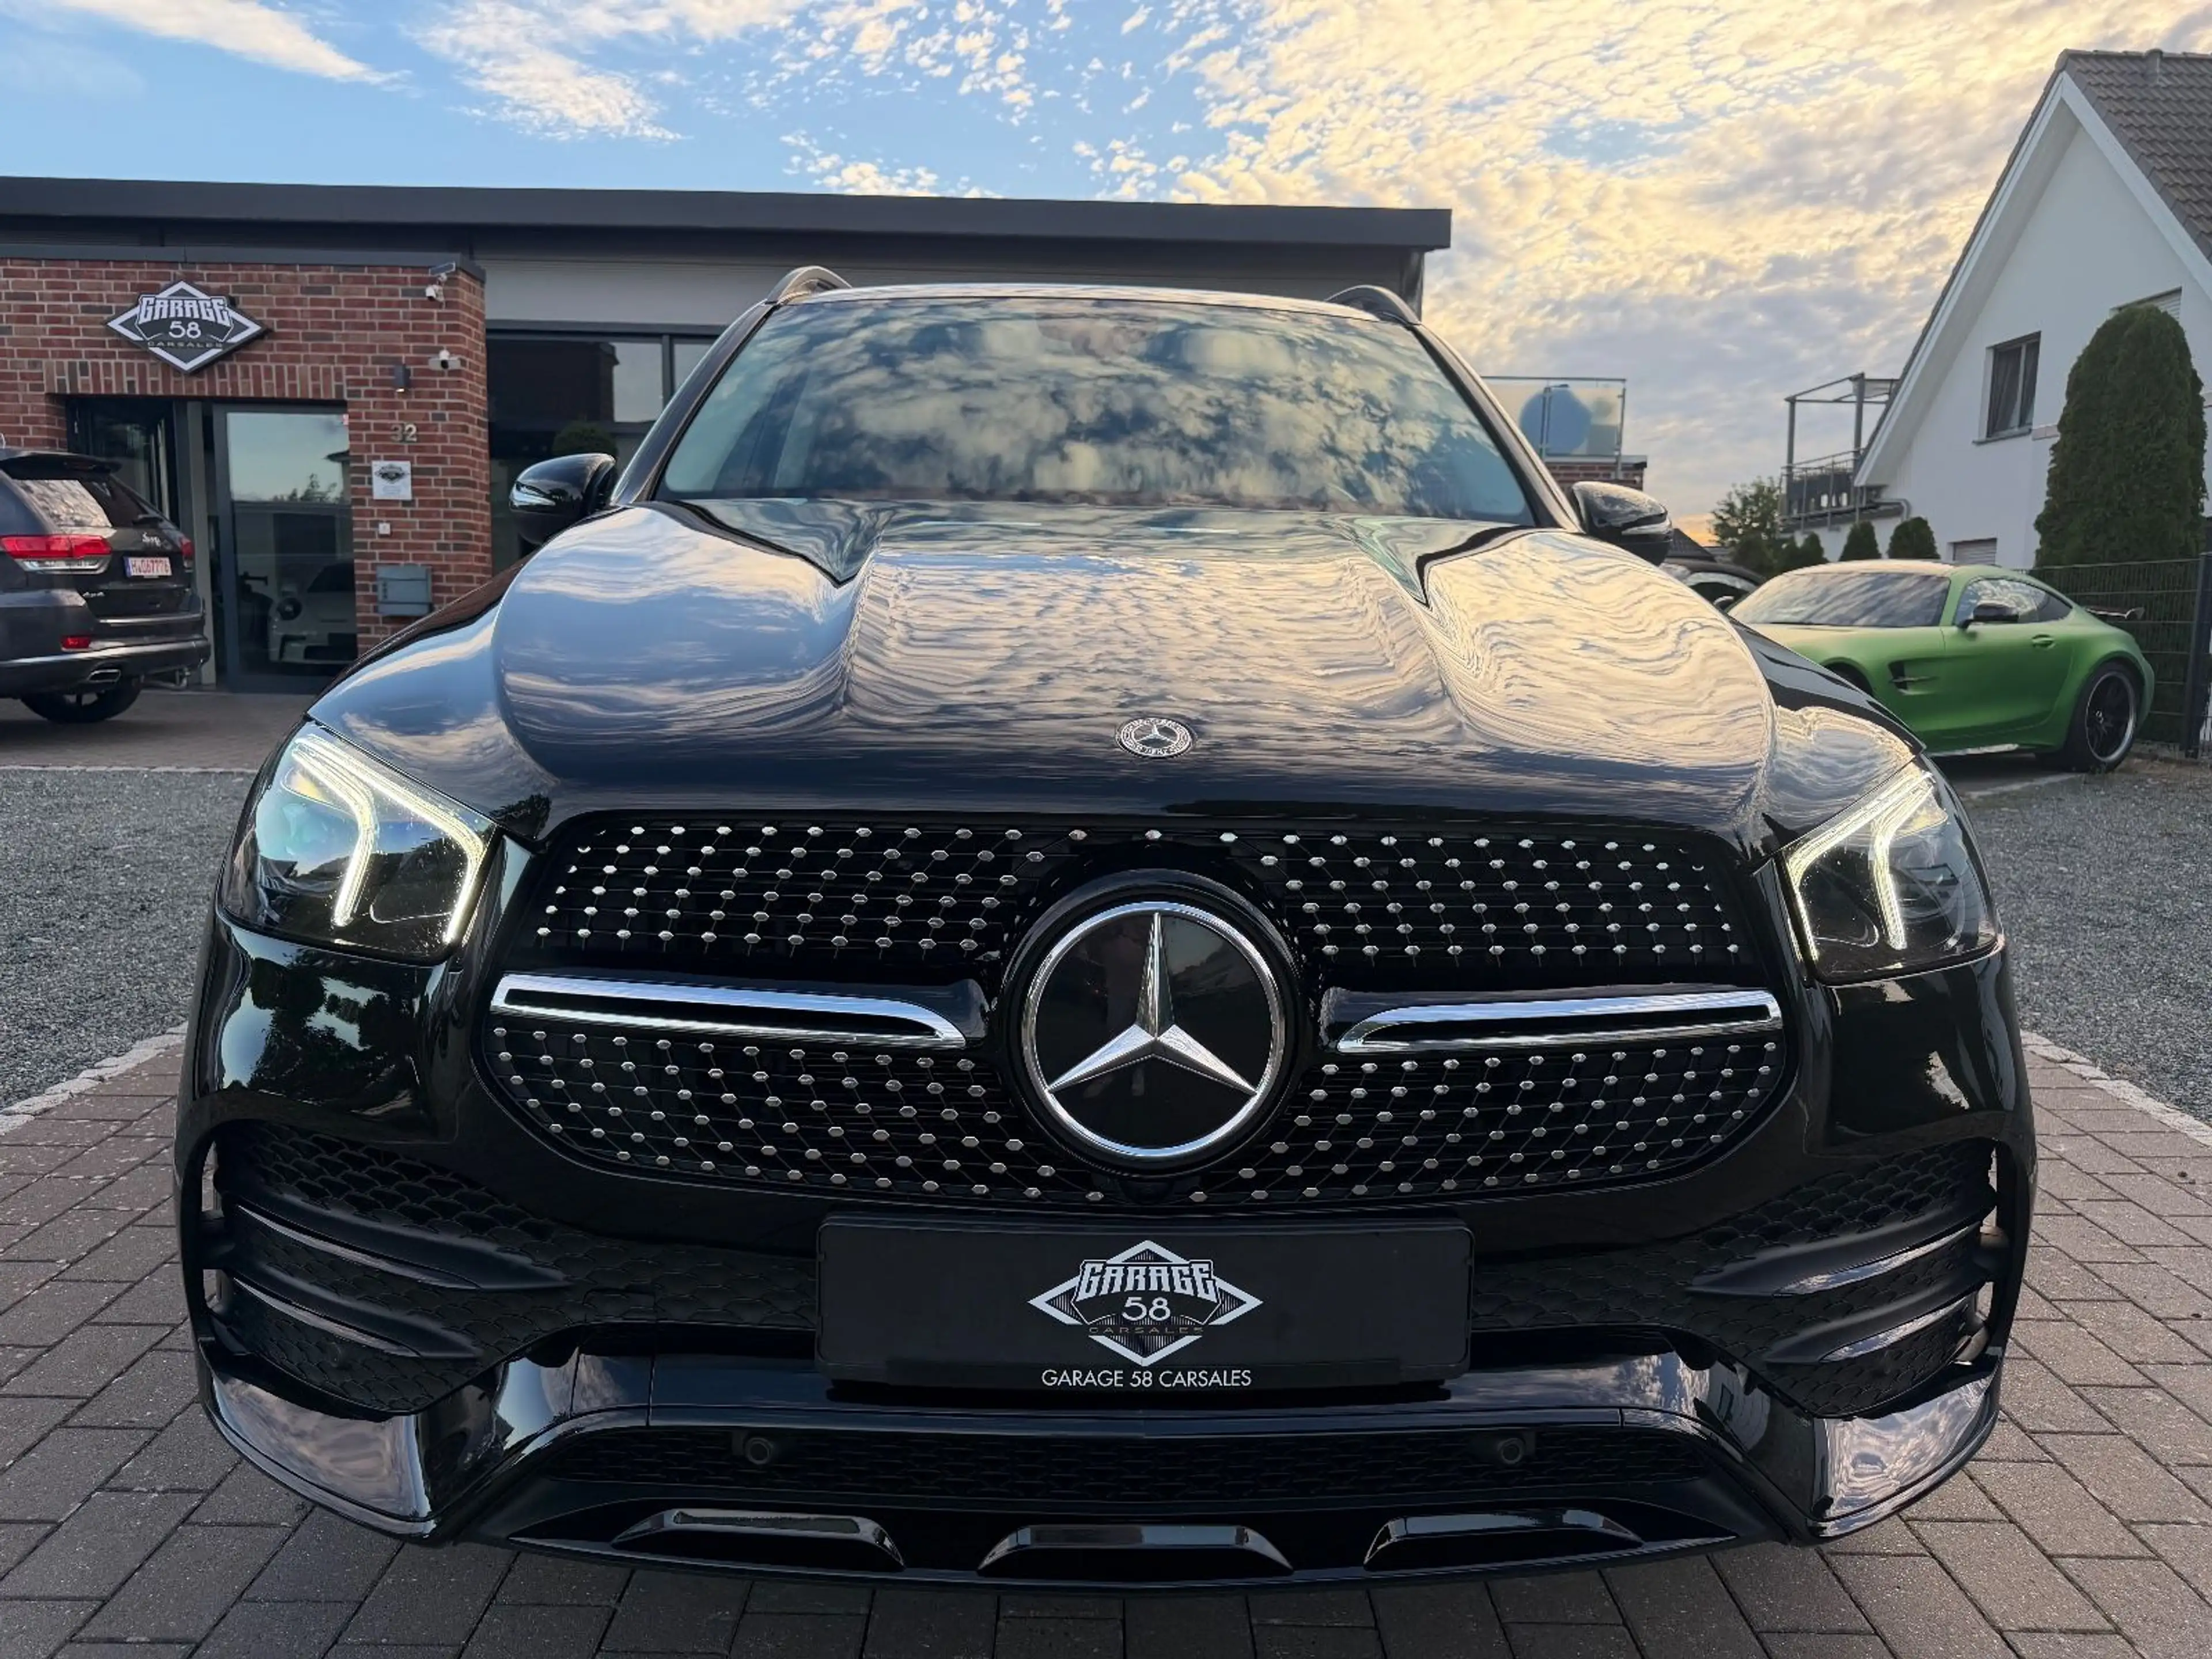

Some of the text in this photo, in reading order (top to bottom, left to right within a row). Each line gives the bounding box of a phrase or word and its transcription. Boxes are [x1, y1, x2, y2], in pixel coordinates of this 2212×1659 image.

[138, 297, 231, 327] GARAGE
[168, 320, 202, 339] 58
[391, 423, 417, 442] 32
[1075, 1263, 1218, 1304] GARAGE
[1122, 1297, 1171, 1321] 58
[1041, 1369, 1252, 1388] GARAGE 58 CARSALES
